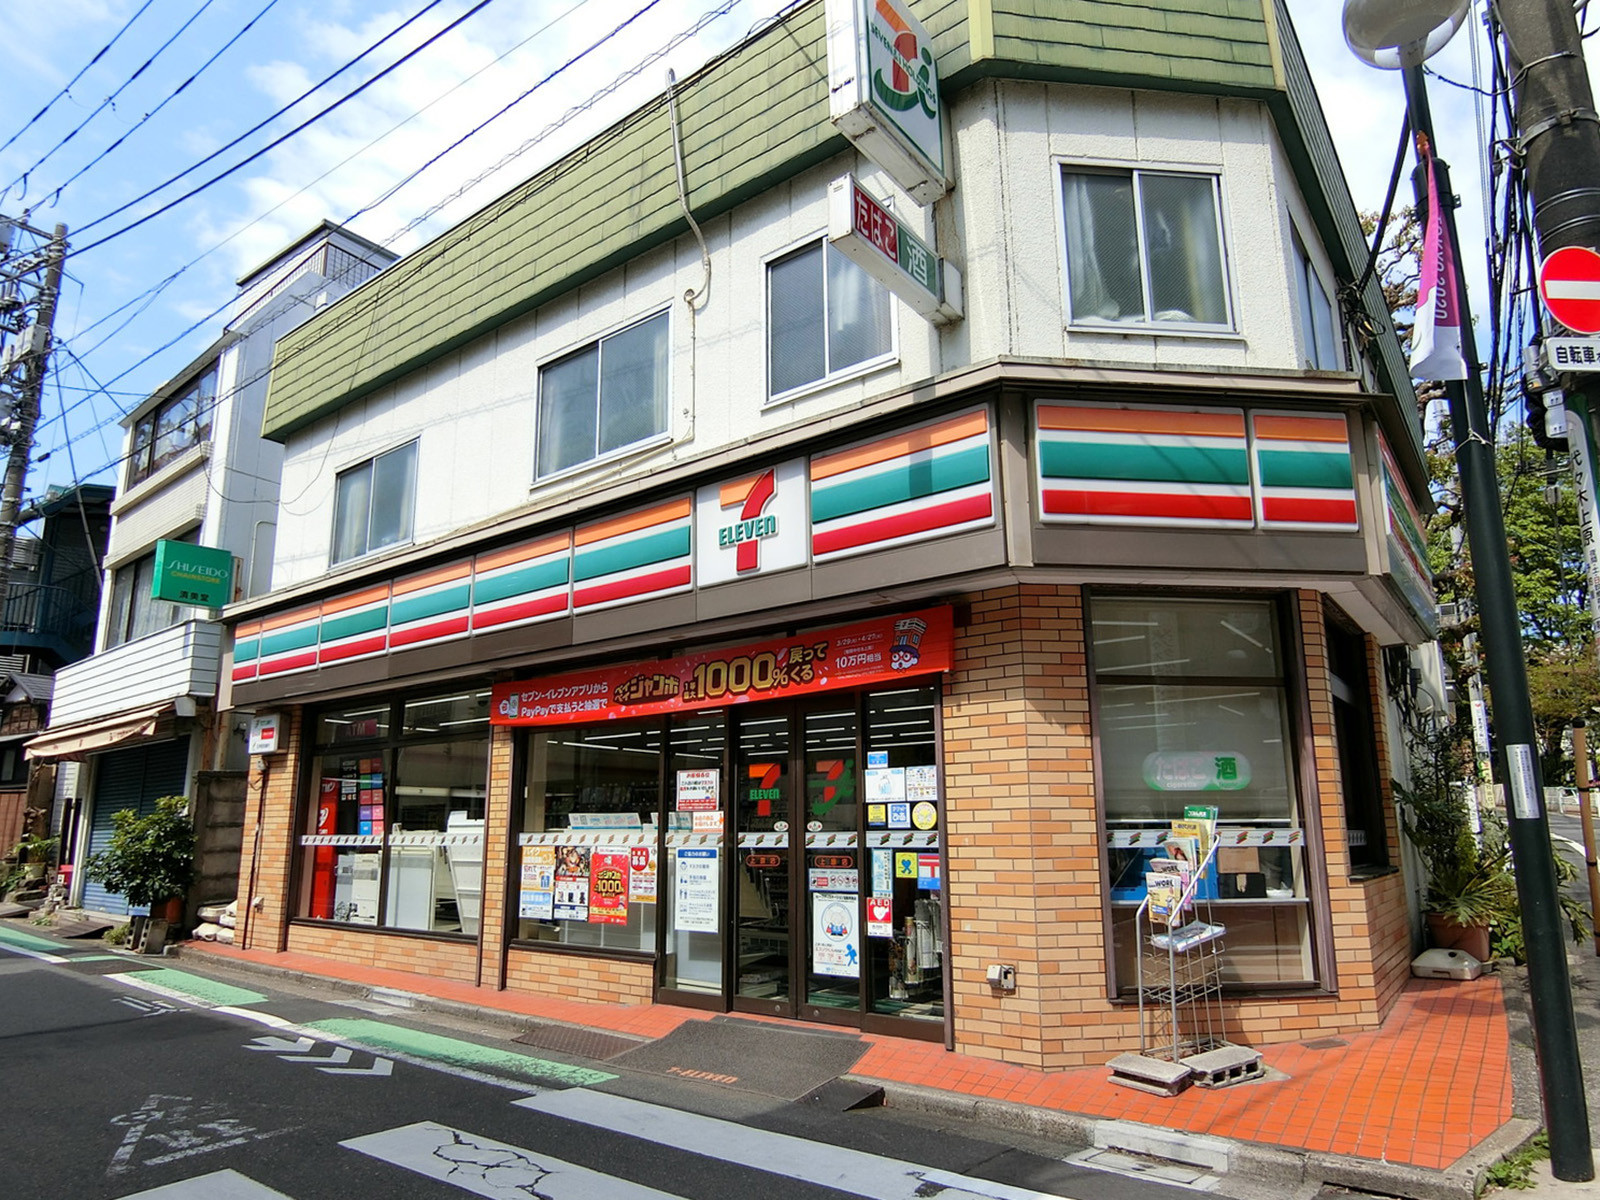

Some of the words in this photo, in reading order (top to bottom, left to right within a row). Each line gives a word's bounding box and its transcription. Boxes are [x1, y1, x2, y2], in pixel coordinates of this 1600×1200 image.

[857, 192, 896, 259] たばこ
[906, 236, 928, 286] 酒
[1434, 281, 1448, 320] 2020
[1571, 450, 1595, 547] 代々木上原
[166, 560, 229, 579] SHISEIDO
[789, 641, 828, 665] 戻って
[834, 652, 882, 669] 10万円相当
[790, 663, 814, 681] くる
[1214, 757, 1238, 780] 酒
[869, 898, 890, 907] AED
